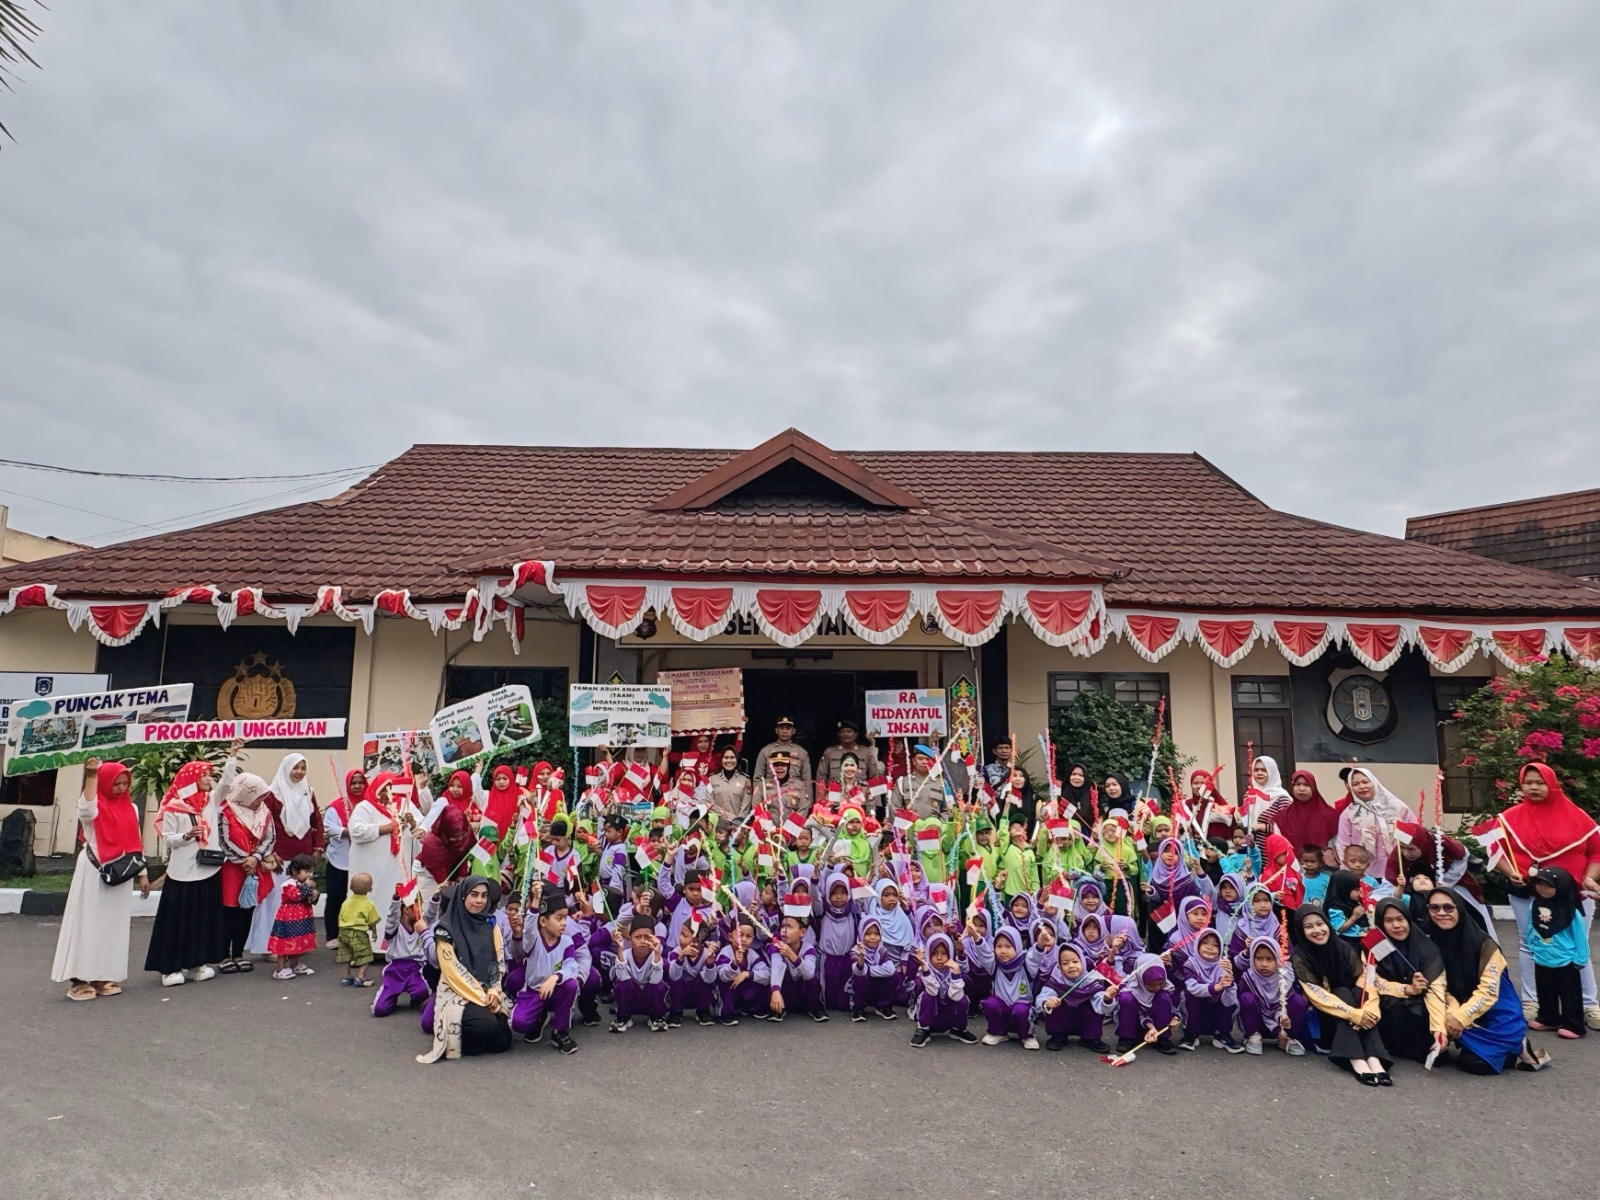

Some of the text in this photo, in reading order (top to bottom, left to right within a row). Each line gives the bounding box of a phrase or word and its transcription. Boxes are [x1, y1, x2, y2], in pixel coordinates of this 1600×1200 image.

[491, 689, 508, 697] Surah
[898, 691, 918, 703] RA
[54, 690, 169, 715] PUNCAK TEMA
[871, 707, 943, 719] HIDAYATUL
[144, 721, 328, 741] PROGRAM UNGGULAN
[886, 722, 930, 734] INSAN
